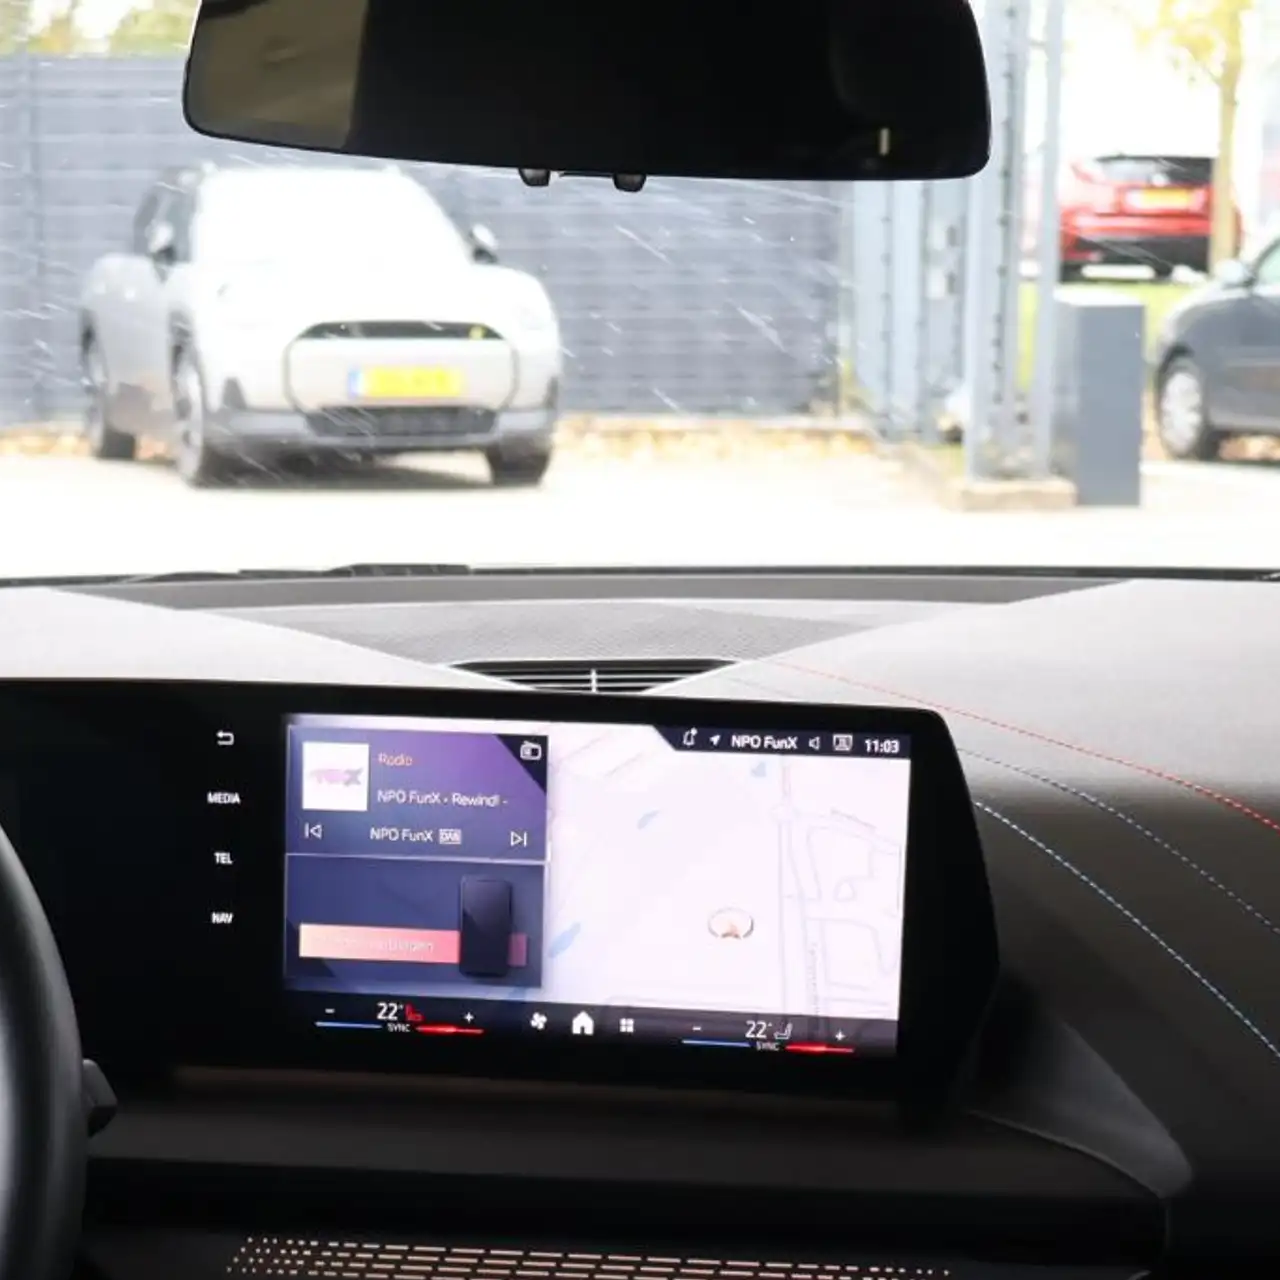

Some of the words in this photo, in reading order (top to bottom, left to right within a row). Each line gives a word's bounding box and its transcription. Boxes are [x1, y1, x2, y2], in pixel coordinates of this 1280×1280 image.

[731, 735, 761, 749] NPO
[763, 736, 797, 750] FunX
[865, 738, 900, 754] 11:03
[378, 752, 413, 767] Radio
[206, 792, 241, 804] MEDIA
[378, 790, 407, 804] NPO
[409, 791, 440, 805] FunX
[370, 827, 399, 842] NPO
[402, 828, 434, 843] FunX
[214, 852, 234, 865] TEL
[211, 911, 234, 924] NAV
[387, 1022, 412, 1034] SYNC
